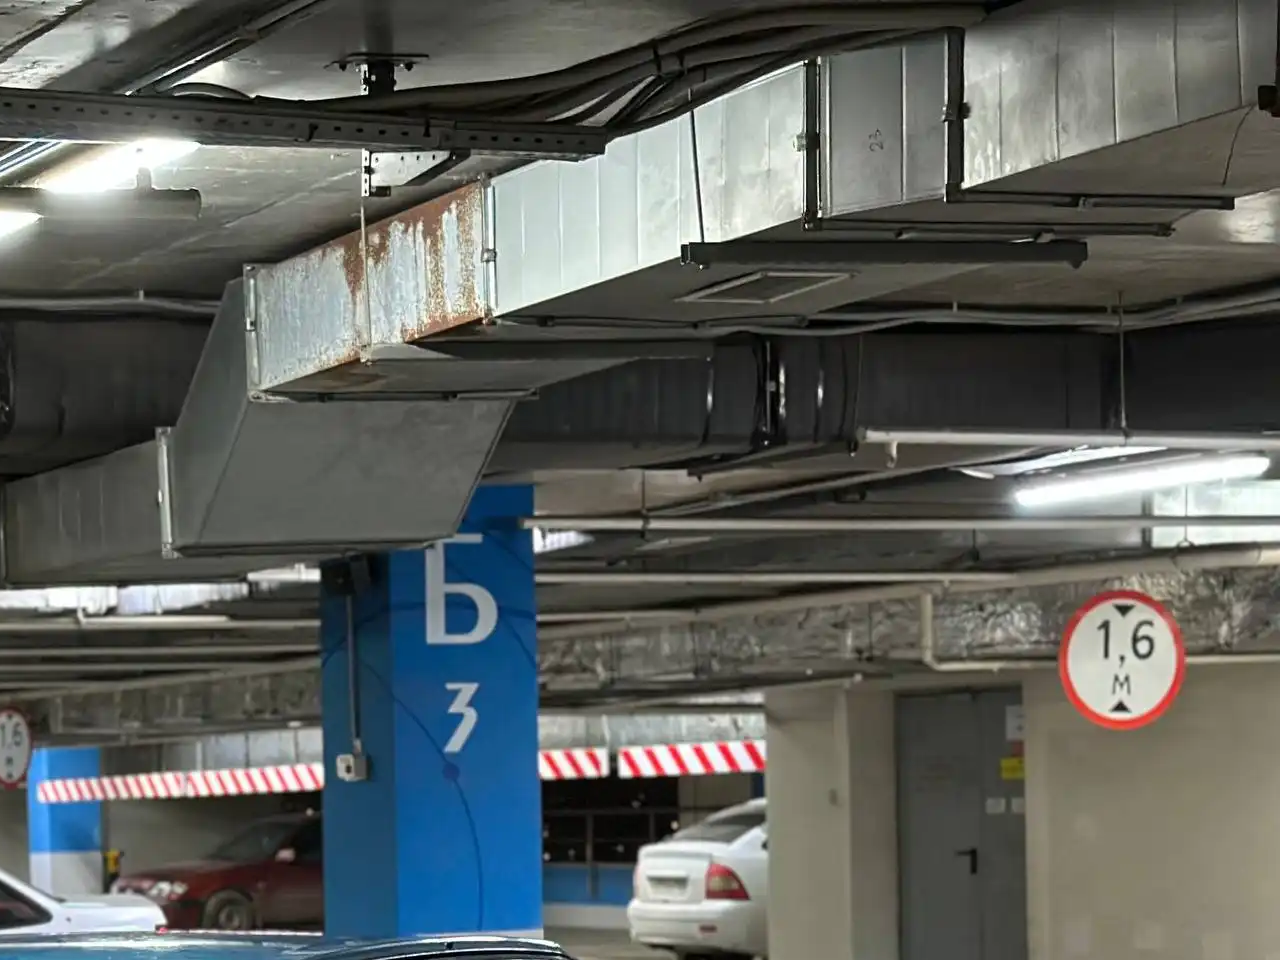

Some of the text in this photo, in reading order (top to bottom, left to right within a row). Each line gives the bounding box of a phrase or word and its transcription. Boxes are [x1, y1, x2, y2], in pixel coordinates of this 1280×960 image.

[424, 533, 498, 645] Б
[1096, 618, 1155, 668] 1,6
[444, 682, 480, 753] 3
